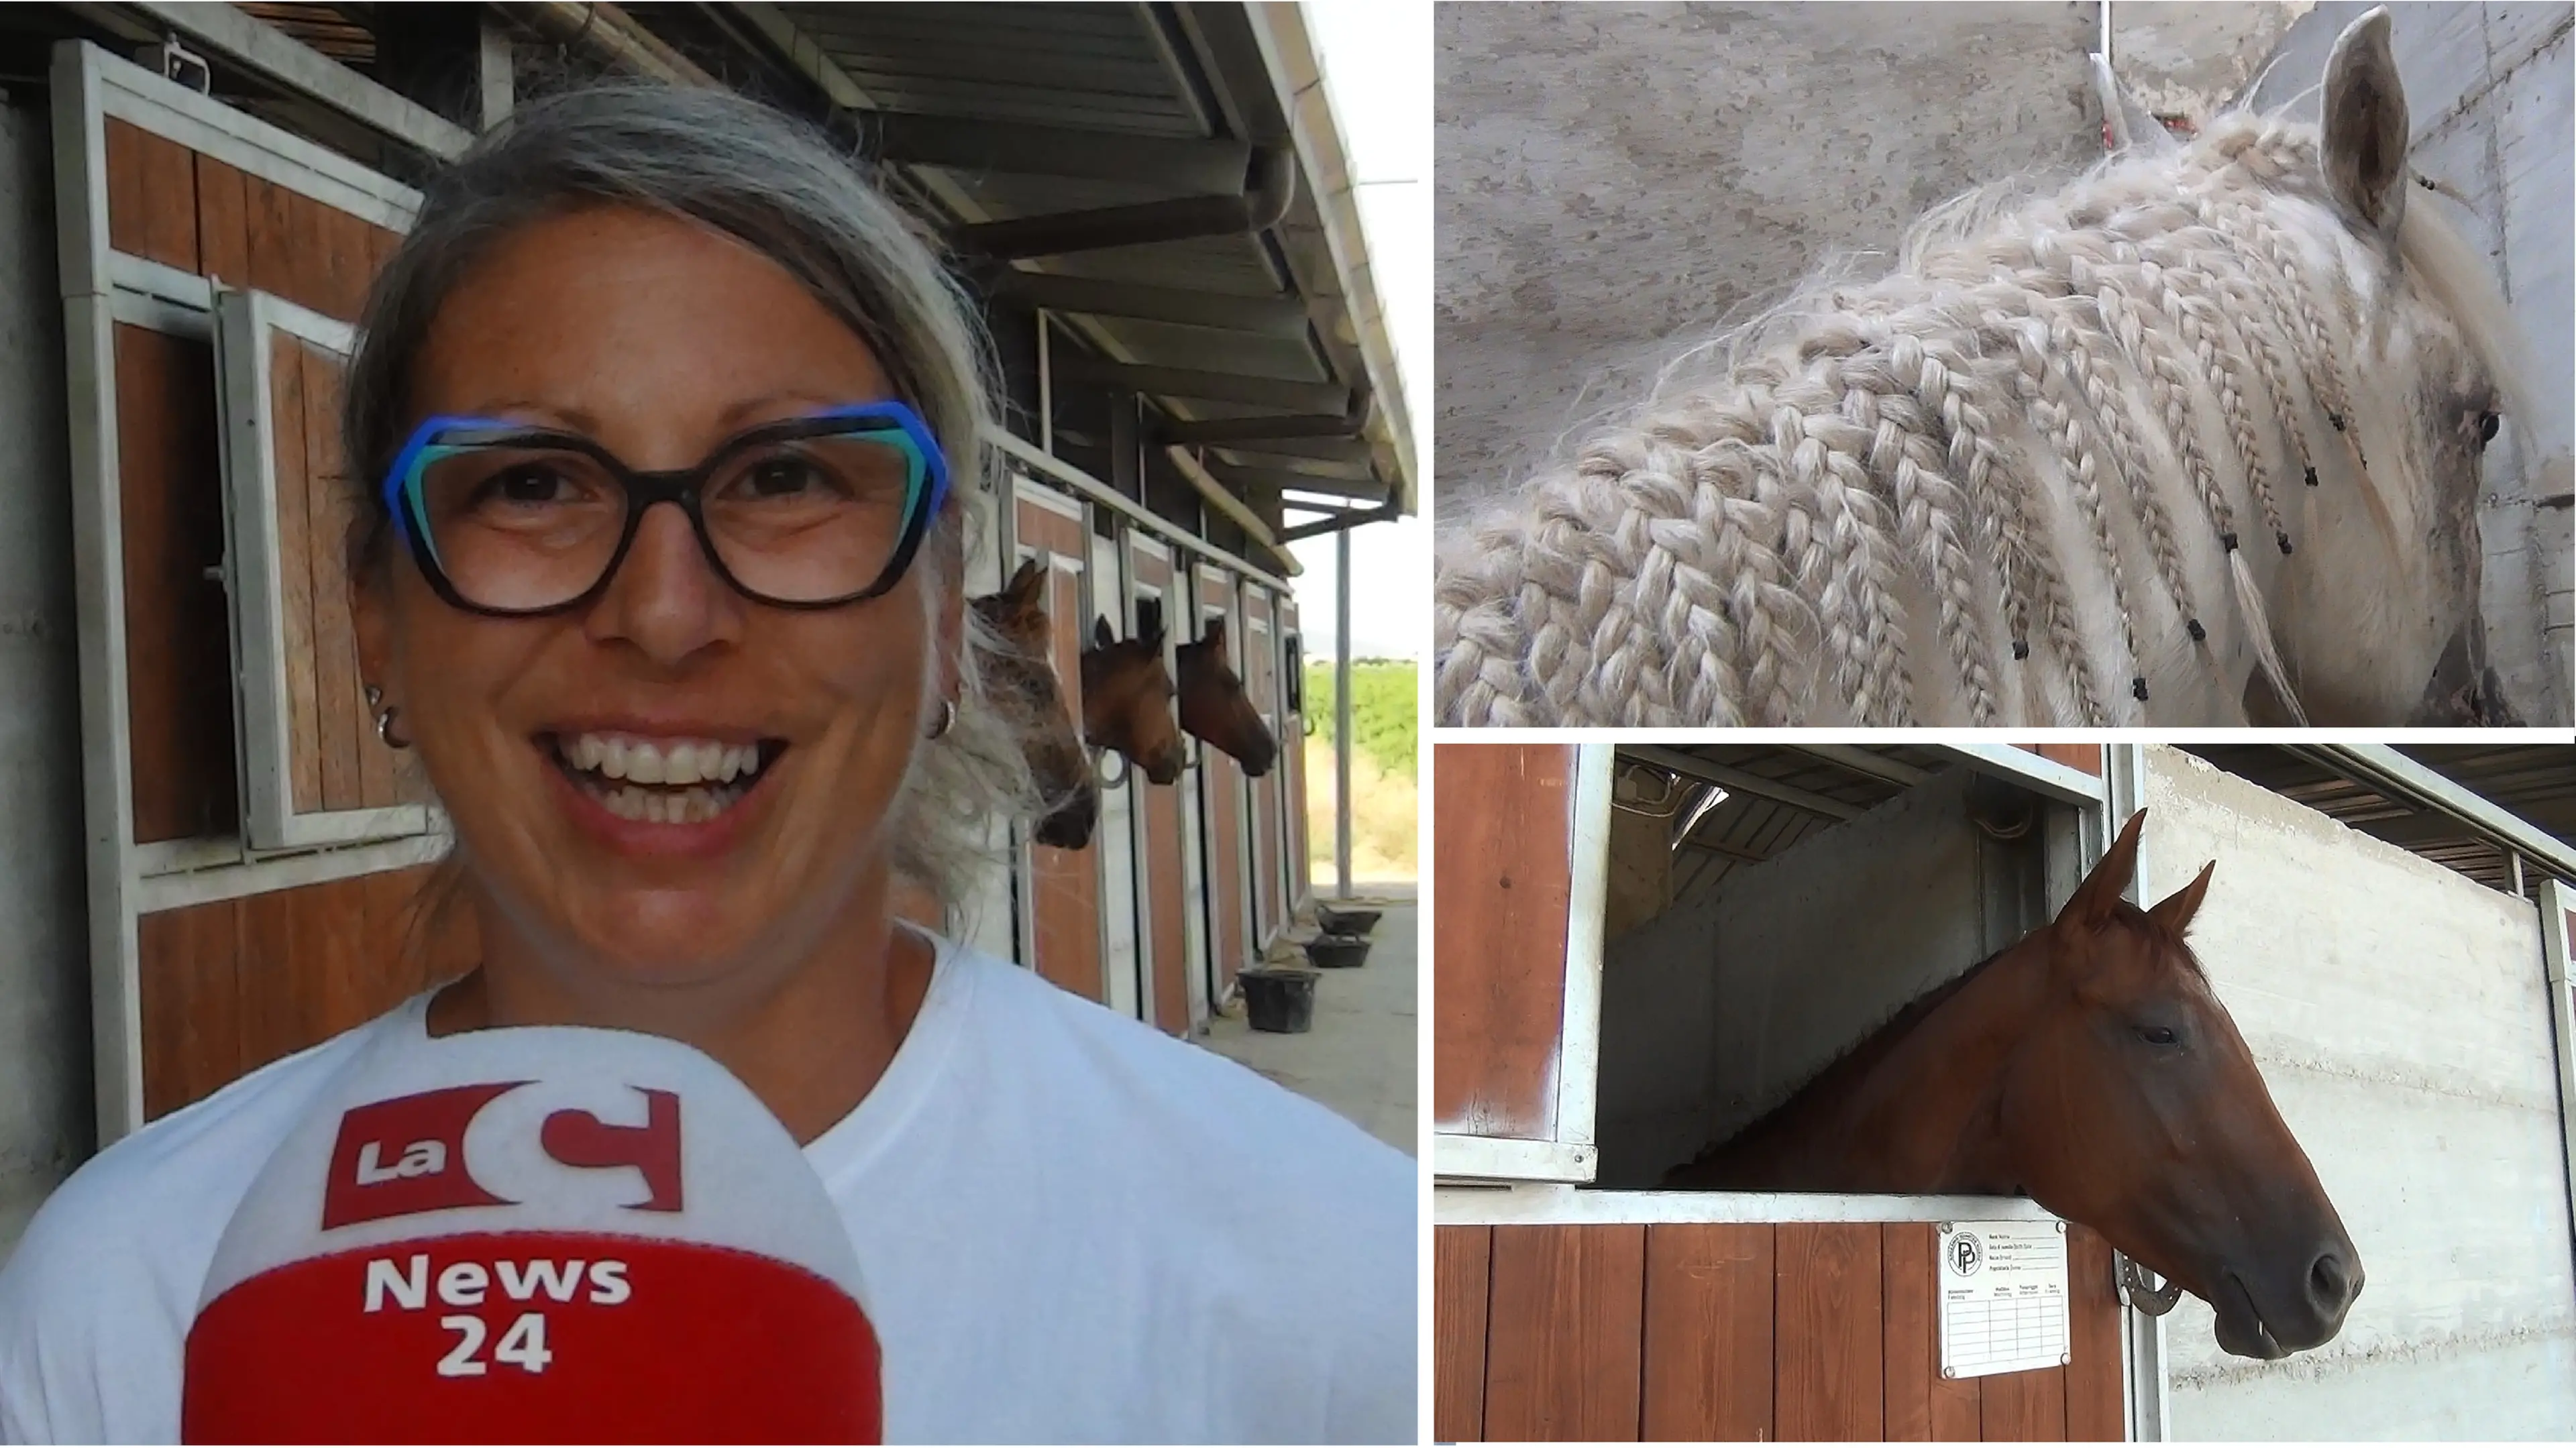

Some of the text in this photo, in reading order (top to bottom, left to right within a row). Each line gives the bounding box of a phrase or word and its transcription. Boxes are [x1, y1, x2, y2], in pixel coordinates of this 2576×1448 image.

[356, 1141, 446, 1184] La
[364, 1255, 631, 1311] News
[437, 1314, 552, 1376] 24
